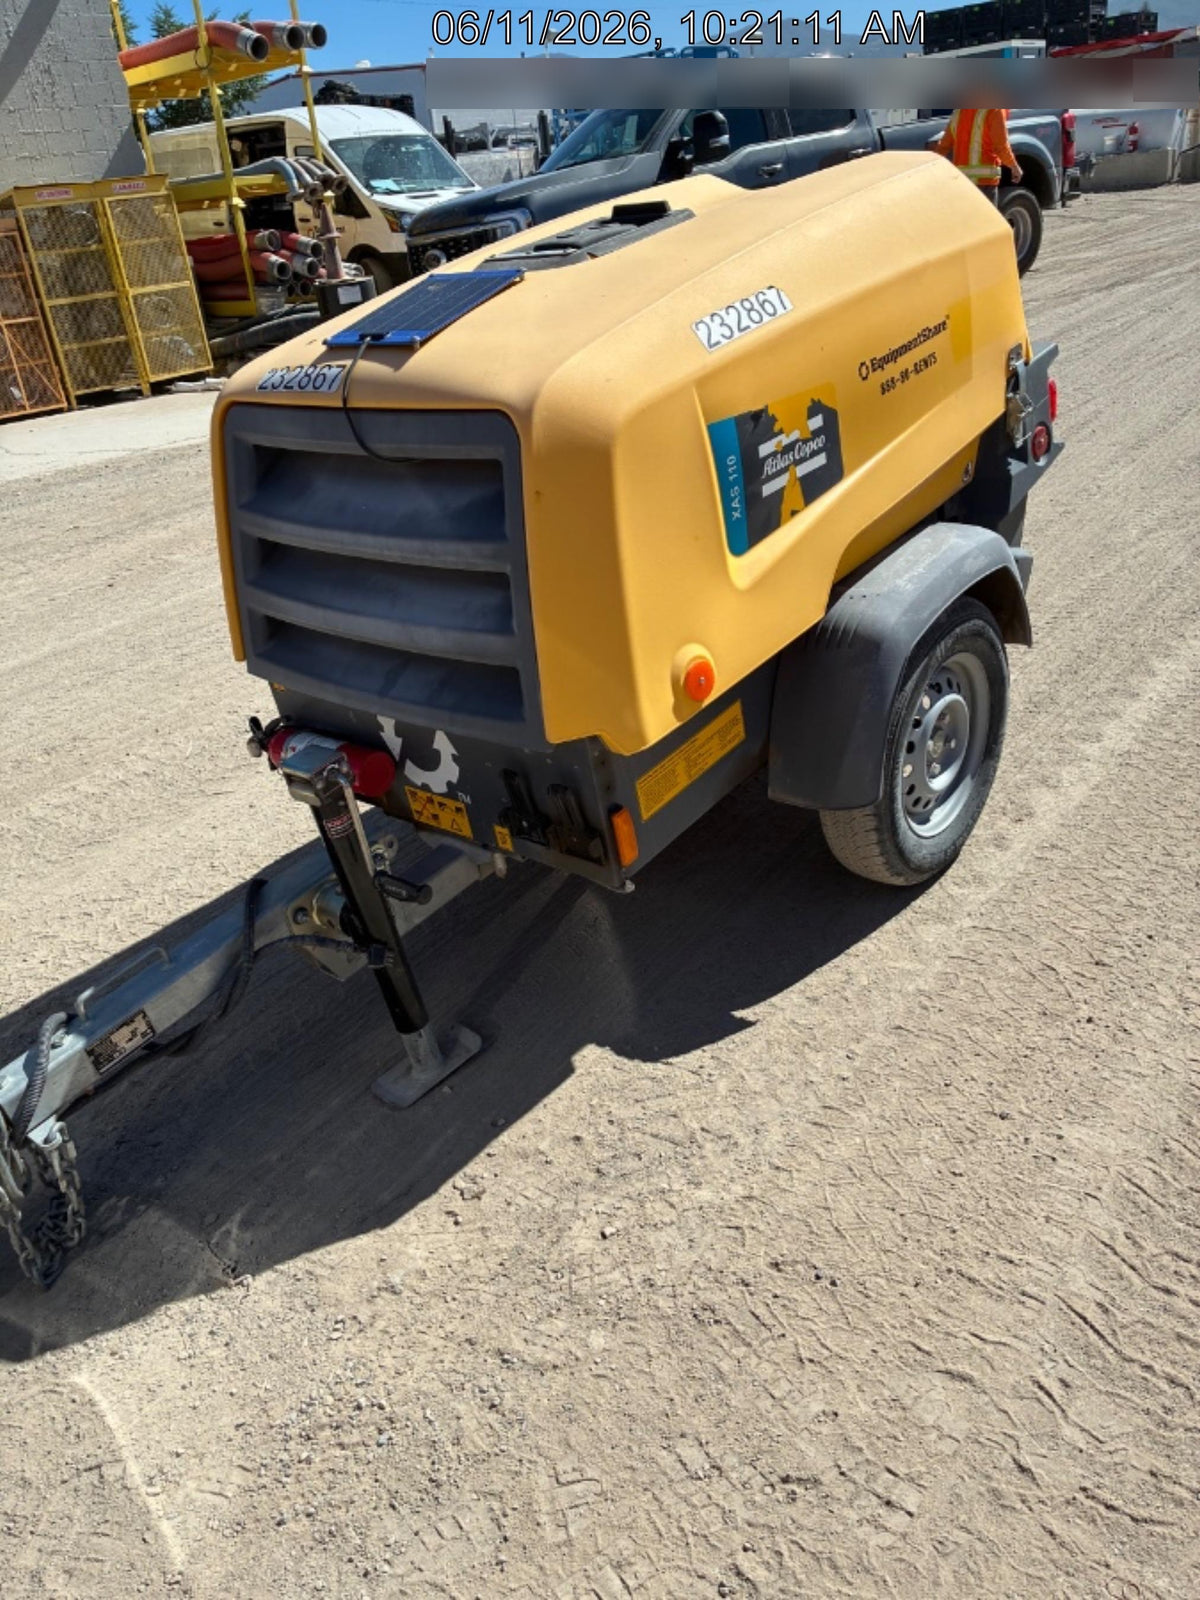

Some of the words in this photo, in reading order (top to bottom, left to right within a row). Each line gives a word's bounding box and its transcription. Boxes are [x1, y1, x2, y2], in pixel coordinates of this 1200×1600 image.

[694, 285, 787, 350] 232867
[257, 364, 347, 391] 232867
[727, 454, 739, 483] 110
[761, 450, 794, 479] Atlas
[731, 485, 741, 521] XAS
